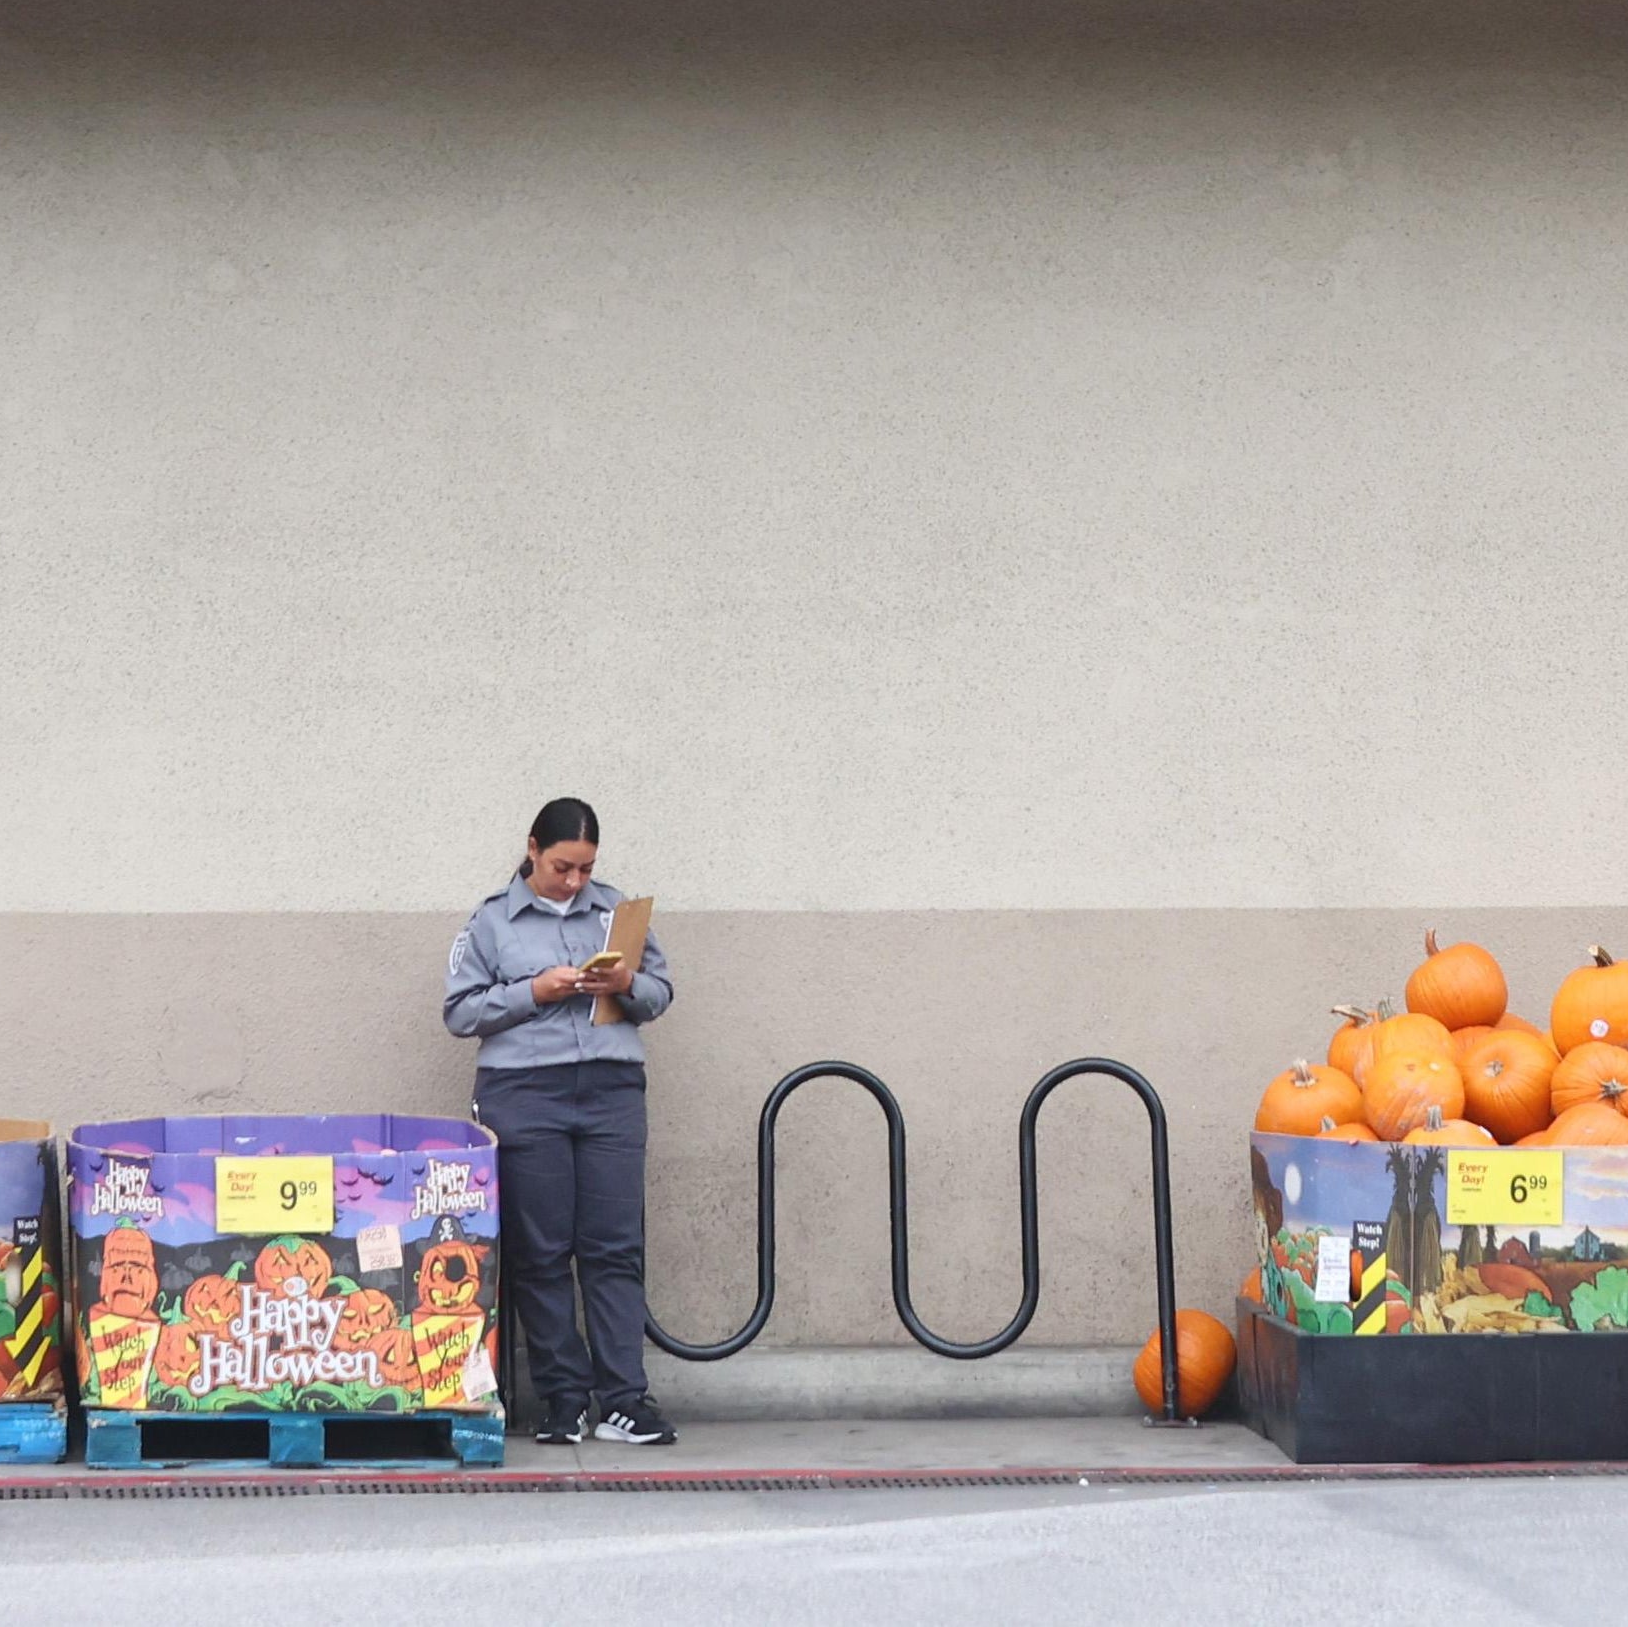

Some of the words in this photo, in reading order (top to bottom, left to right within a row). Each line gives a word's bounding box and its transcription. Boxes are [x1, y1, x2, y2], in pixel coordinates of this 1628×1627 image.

[105, 1157, 150, 1196] Happy
[227, 1170, 257, 1182] Every
[425, 1157, 471, 1194] Happy
[1458, 1162, 1488, 1174] Every
[1461, 1174, 1485, 1185] Day!
[91, 1182, 164, 1218] Halloween
[230, 1182, 255, 1193] Day!
[411, 1185, 488, 1220] Halloween
[16, 1219, 39, 1230] Watch
[18, 1232, 38, 1245] Step!
[1356, 1222, 1383, 1235] Watch
[1358, 1236, 1380, 1251] Step!
[230, 1283, 348, 1352] Happy
[102, 1325, 145, 1354] Watch
[425, 1322, 470, 1350] Watch
[189, 1332, 383, 1396] Halloween
[103, 1368, 136, 1399] Step
[428, 1368, 461, 1398] Step
